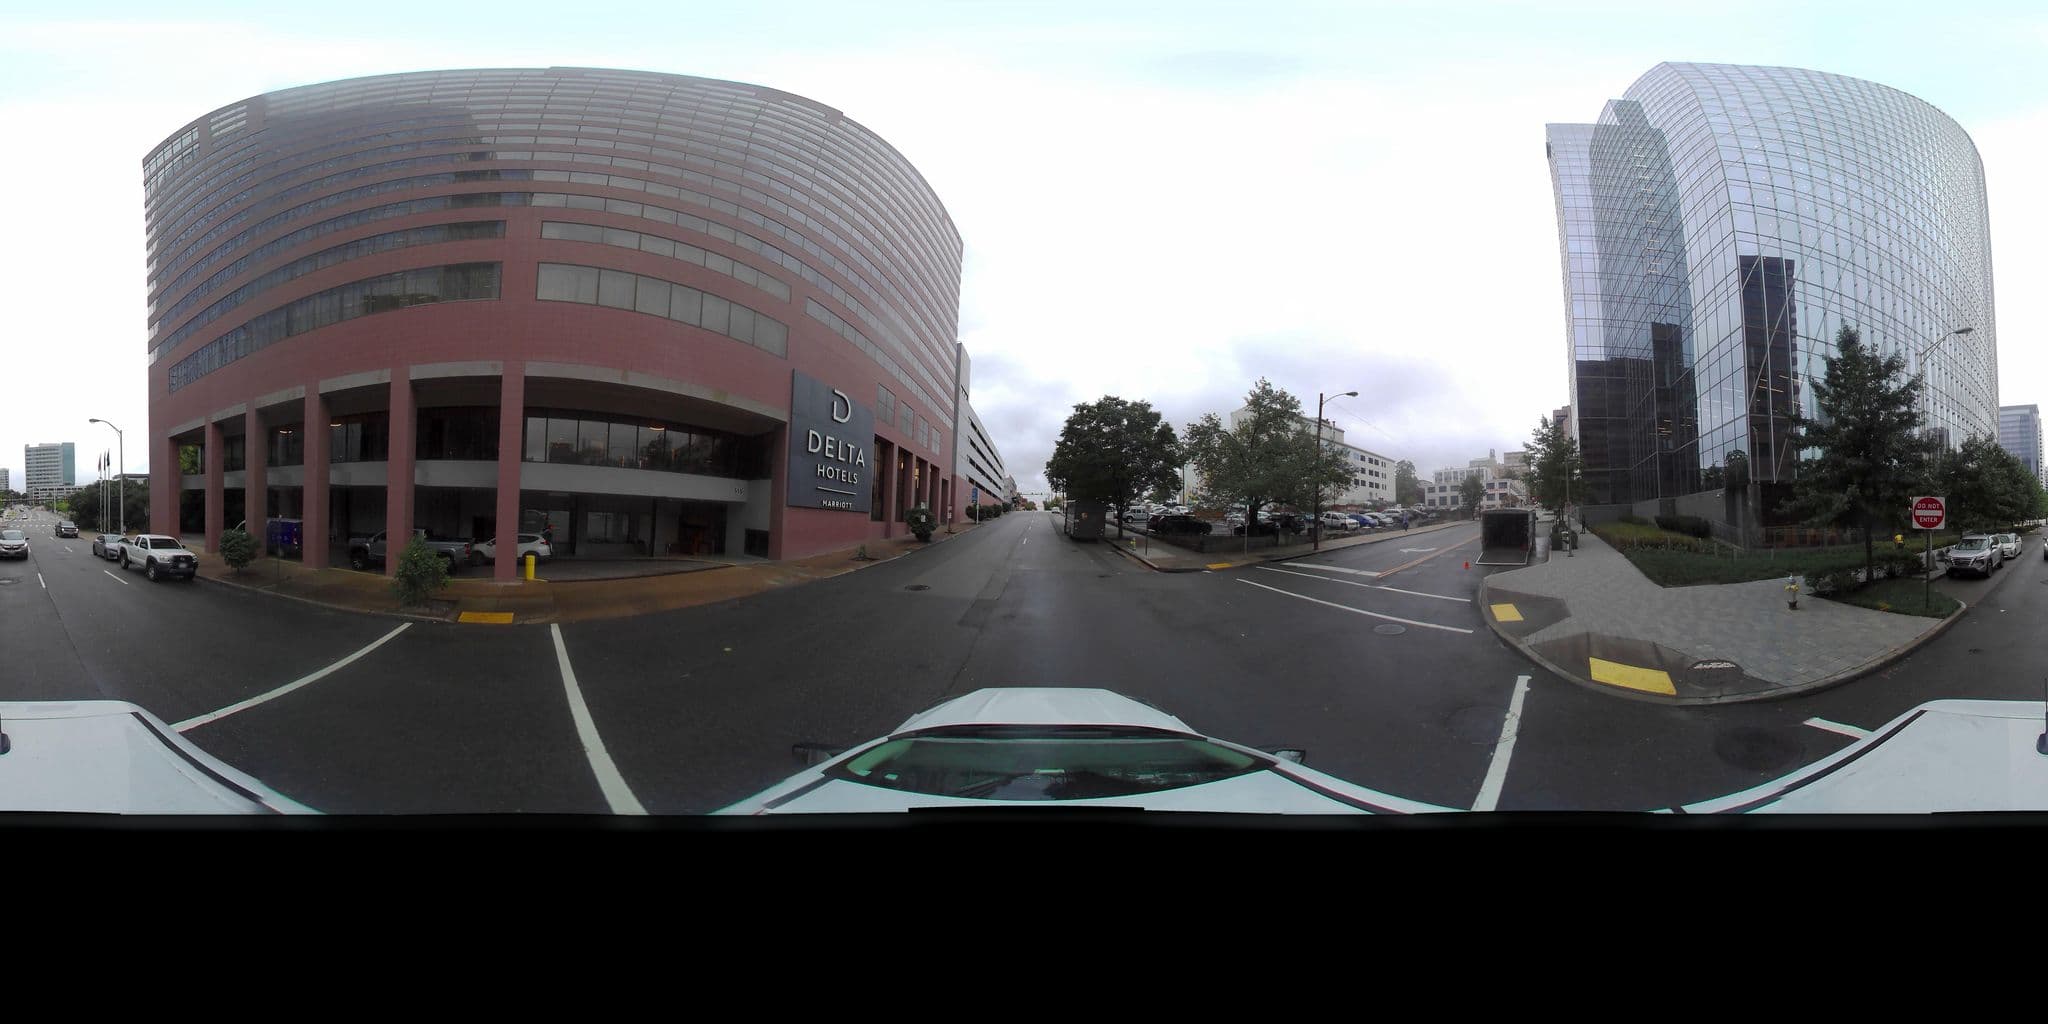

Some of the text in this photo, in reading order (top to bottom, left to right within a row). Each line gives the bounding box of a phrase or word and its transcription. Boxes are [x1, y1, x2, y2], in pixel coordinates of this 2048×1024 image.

[808, 429, 865, 467] DELTA
[817, 463, 858, 485] HOTELS
[822, 499, 853, 509] MARRIOTT
